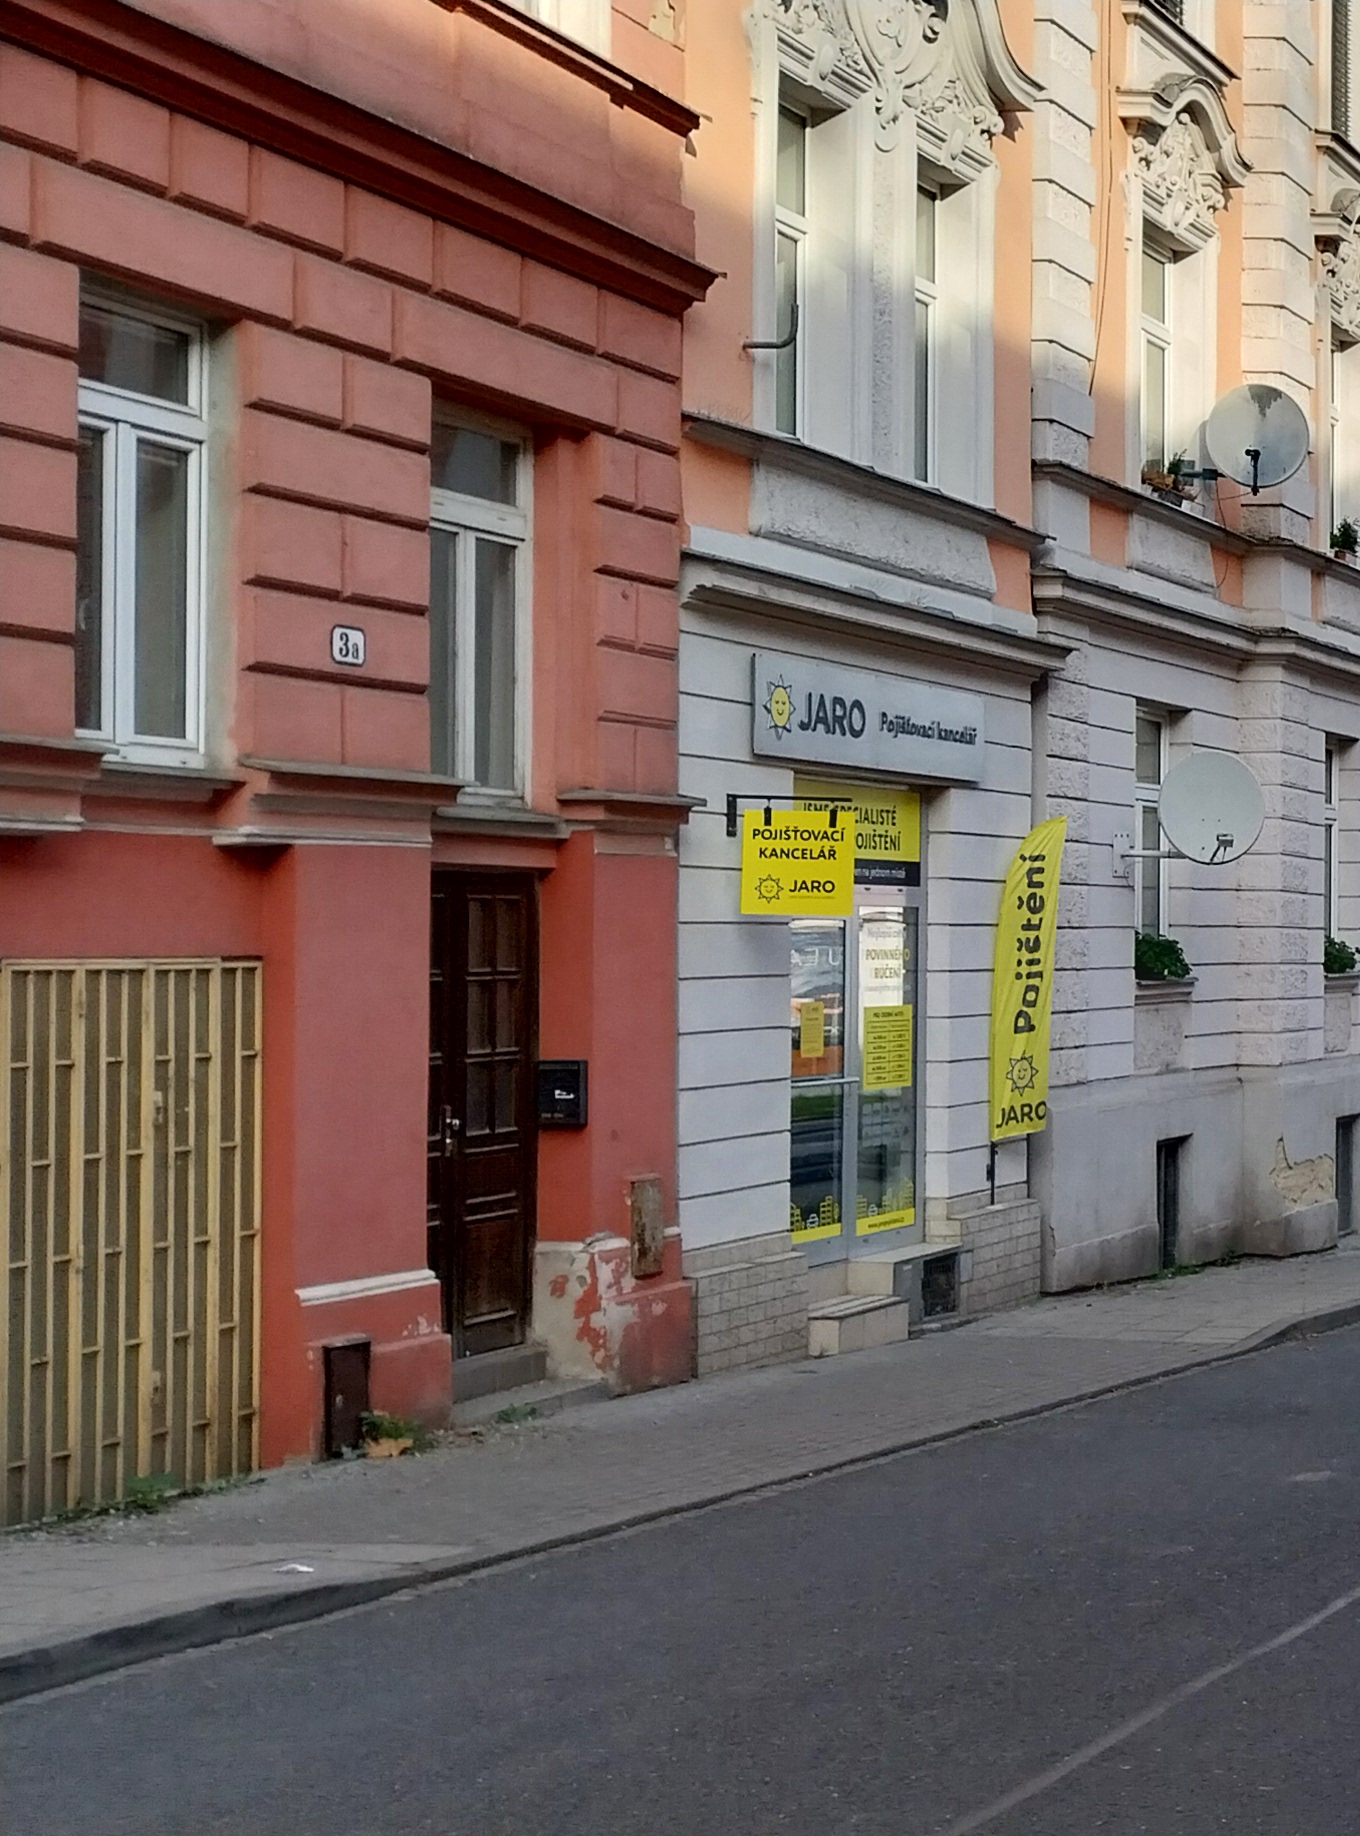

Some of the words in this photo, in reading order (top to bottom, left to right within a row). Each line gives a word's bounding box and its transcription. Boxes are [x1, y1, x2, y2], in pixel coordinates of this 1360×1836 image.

[339, 631, 360, 661] 3a
[797, 691, 867, 739] JARO
[752, 825, 846, 842] POJIŠŤOVACÍ
[855, 829, 902, 851] OJIŠTĚNÍ
[758, 845, 837, 861] KANCELÁŘ
[788, 879, 836, 894] JARO
[1013, 853, 1046, 1035] Pojištění
[995, 1100, 1047, 1129] JARO
